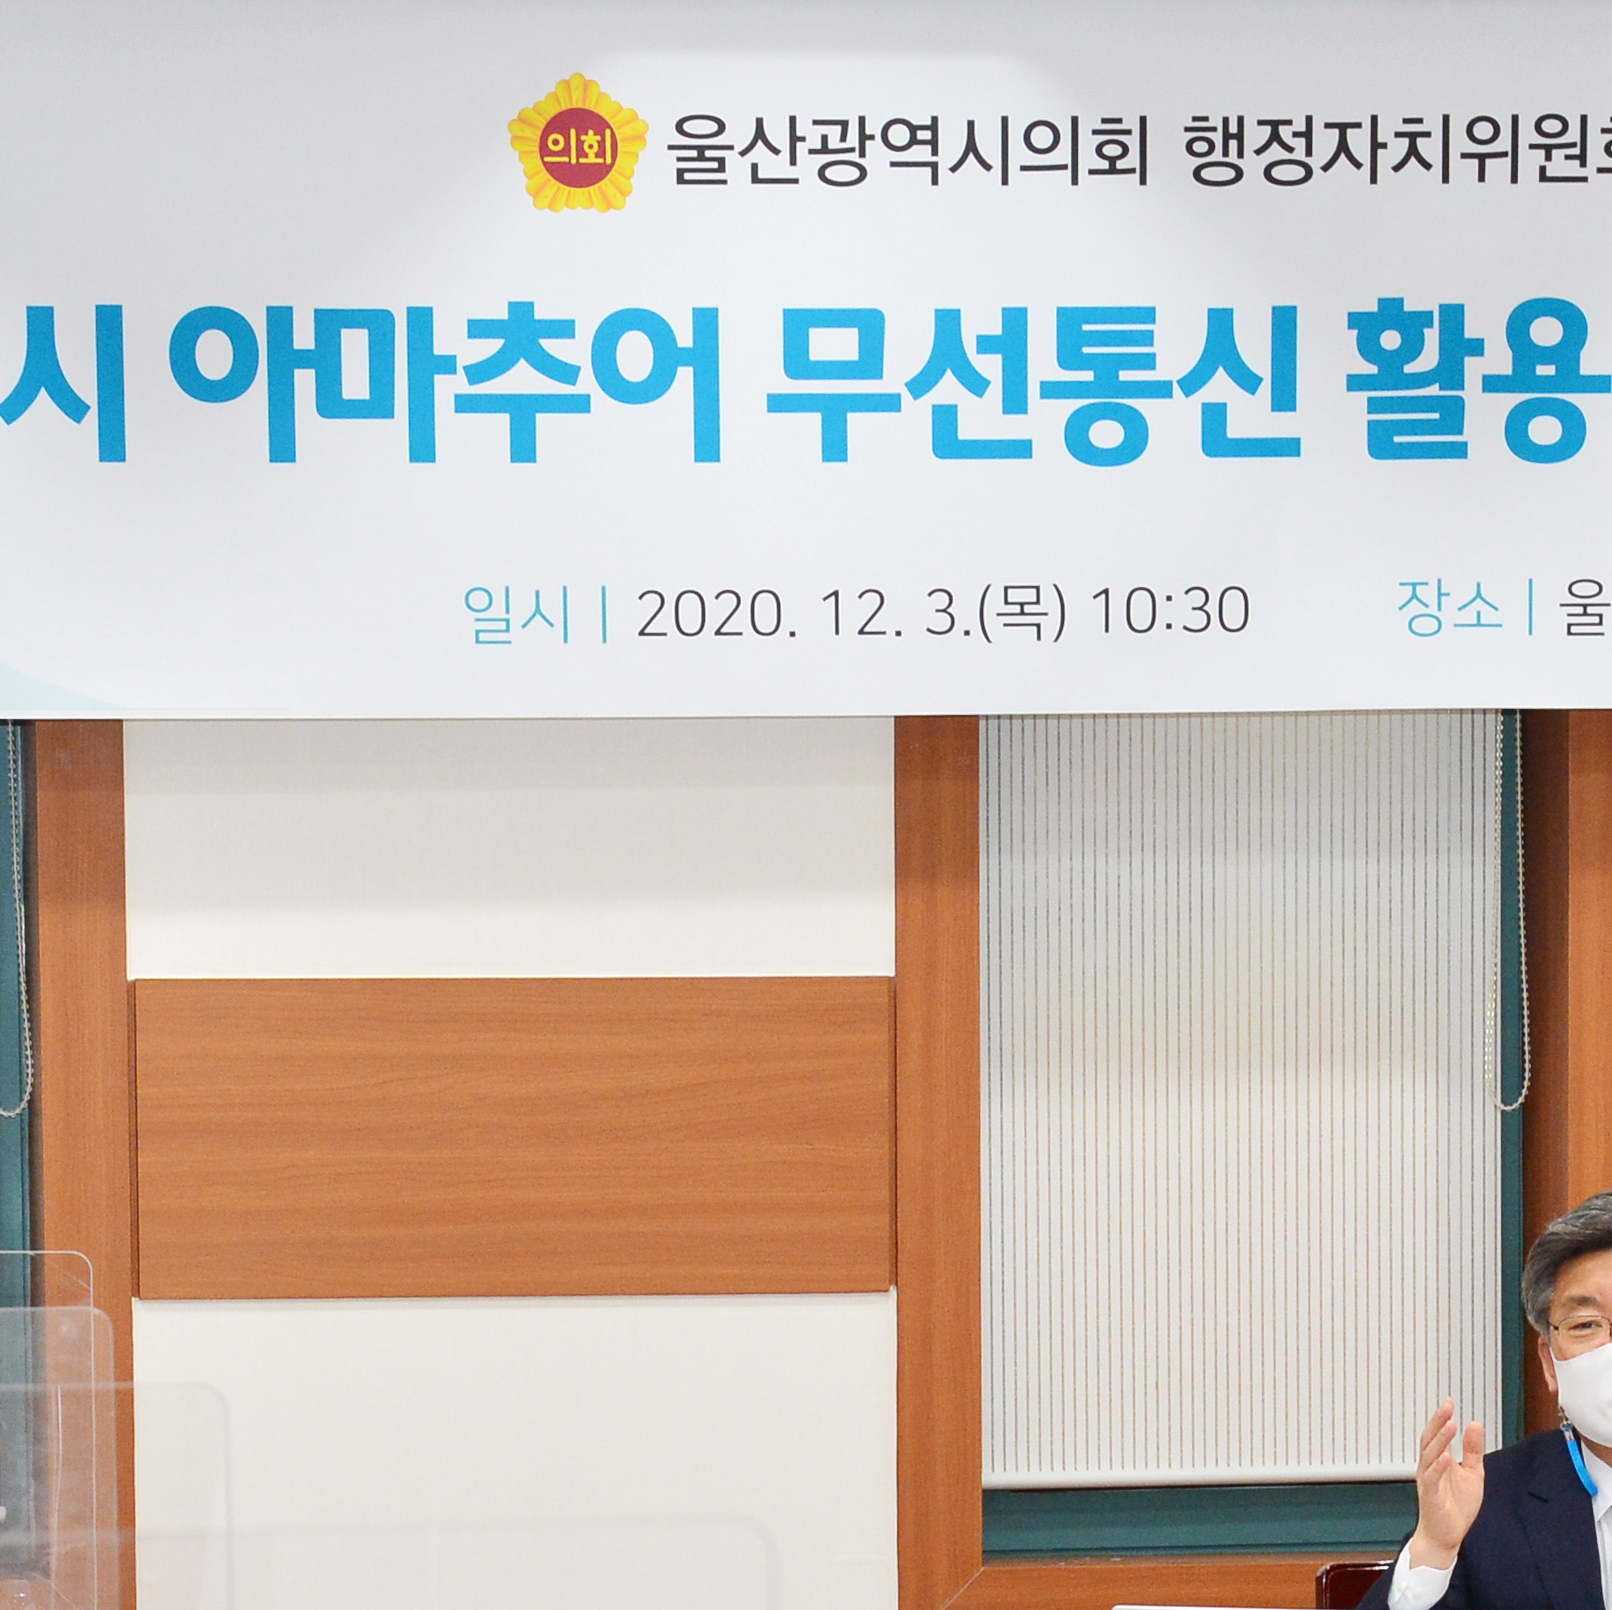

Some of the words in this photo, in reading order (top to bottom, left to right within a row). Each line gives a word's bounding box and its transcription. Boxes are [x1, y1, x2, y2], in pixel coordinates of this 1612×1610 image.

[544, 131, 613, 166] 의회
[666, 113, 1150, 188] 울산광역시의회
[167, 300, 724, 466] 아마추어
[766, 304, 1304, 469] 무선통신
[462, 585, 571, 646] 일시
[636, 588, 798, 640] 2020.
[822, 588, 904, 639] 12.
[924, 583, 1068, 645] 3.(목)
[1091, 584, 1253, 636] 10:30
[1395, 577, 1504, 639] 장소
